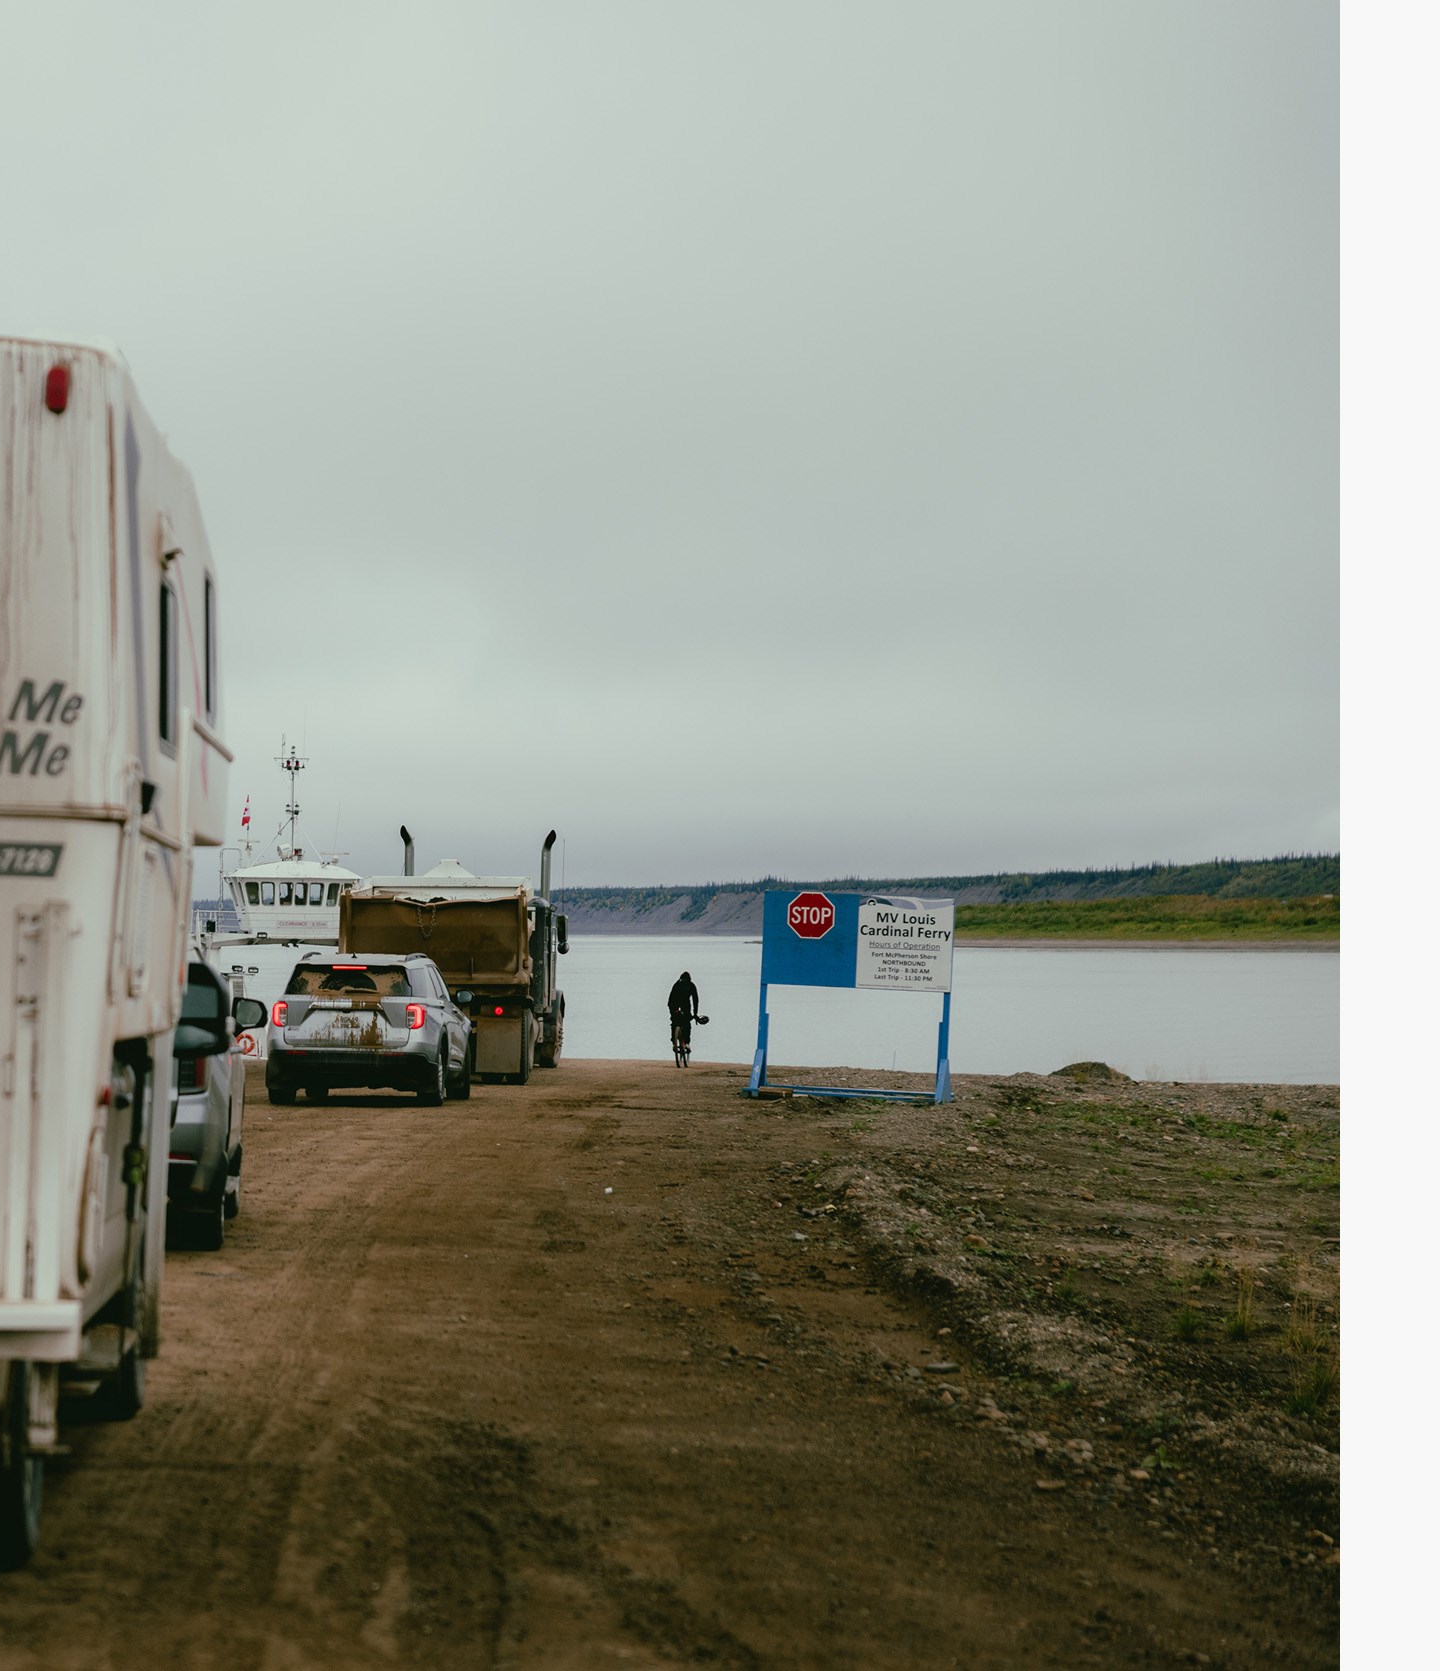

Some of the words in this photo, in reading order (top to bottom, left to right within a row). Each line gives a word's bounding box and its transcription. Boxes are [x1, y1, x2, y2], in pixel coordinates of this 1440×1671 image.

[8, 679, 83, 725] Me
[791, 906, 832, 925] STOP
[876, 912, 899, 924] MV
[903, 913, 936, 926] Louis
[860, 924, 914, 938] Cardinal
[917, 927, 951, 941] Ferry
[869, 941, 891, 949] Hours
[893, 941, 901, 949] of
[903, 942, 941, 951] Operation
[882, 959, 926, 967] NORTHBOUND
[885, 952, 919, 960] McPherson
